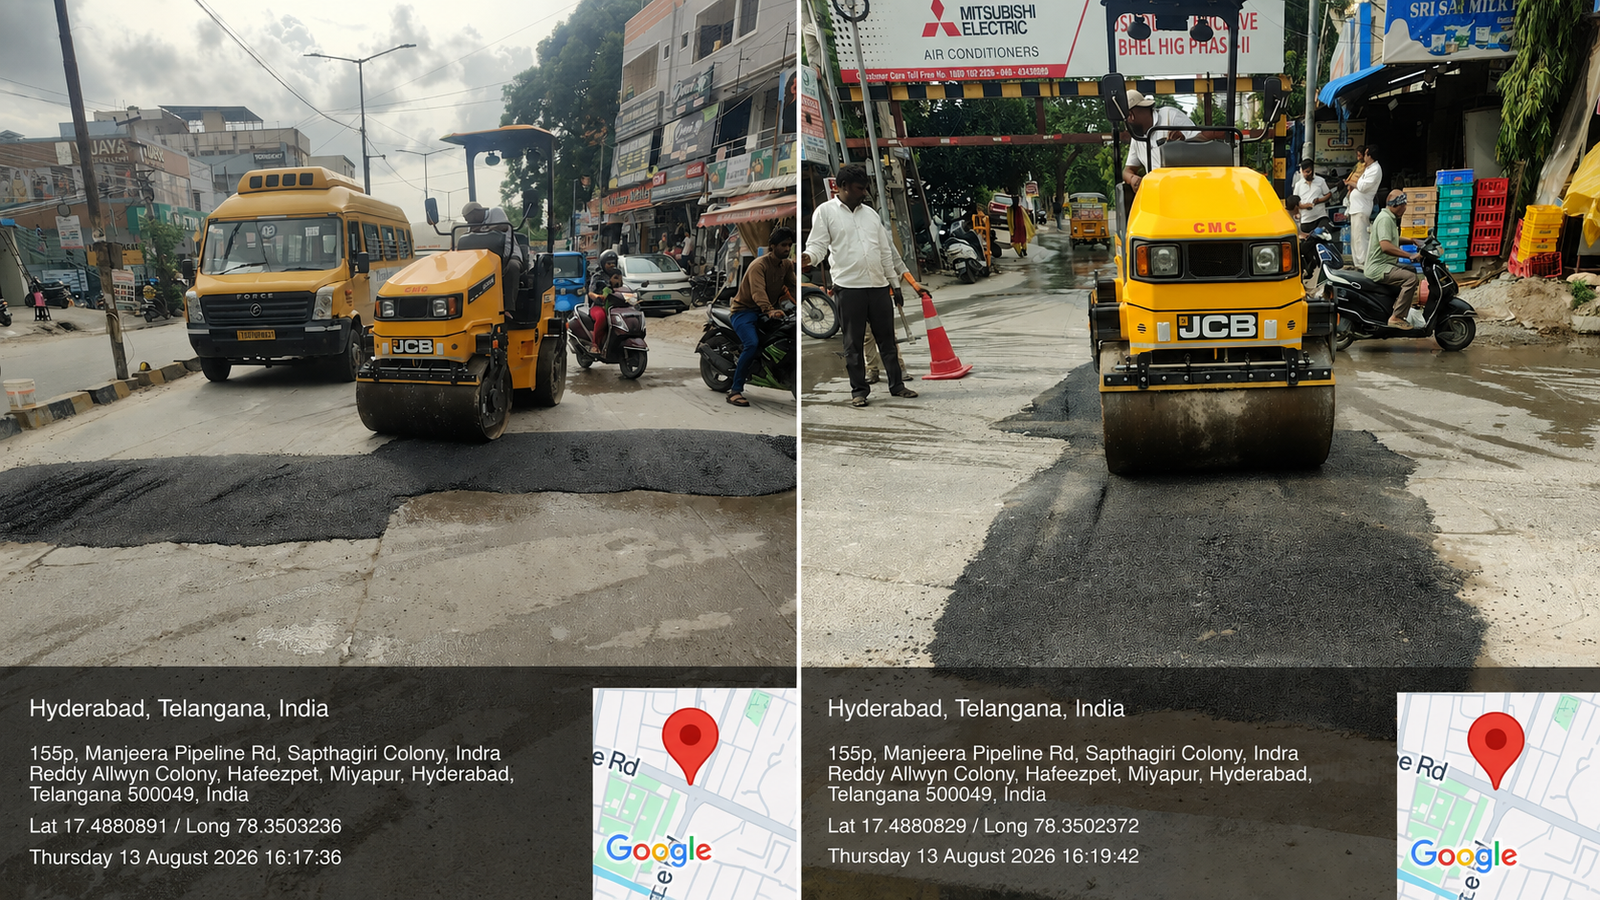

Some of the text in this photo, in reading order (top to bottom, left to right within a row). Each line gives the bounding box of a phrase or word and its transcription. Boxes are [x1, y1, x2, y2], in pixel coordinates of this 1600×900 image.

[960, 4, 1036, 20] MITSUBISHI
[1410, 1, 1435, 18] SRI
[1469, 0, 1508, 14] MILK
[962, 20, 1028, 36] ELECTRIC
[924, 46, 1040, 60] AIR CONDITIONERS
[1119, 36, 1250, 56] BHEL HIG PHAS-II
[1193, 221, 1237, 234] CMC
[1179, 314, 1257, 338] JCB
[392, 340, 433, 353] JCB
